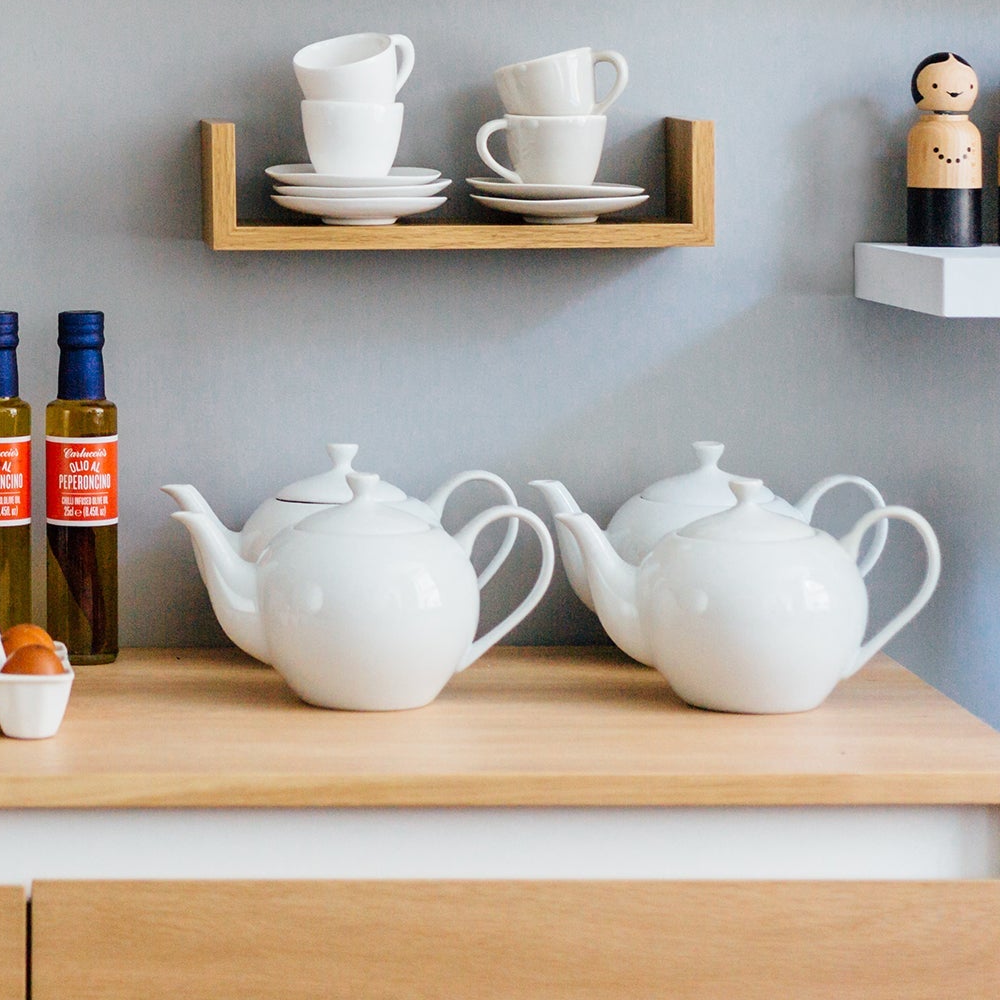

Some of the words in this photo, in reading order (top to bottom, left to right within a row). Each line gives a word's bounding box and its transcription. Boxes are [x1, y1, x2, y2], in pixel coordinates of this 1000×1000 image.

[63, 448, 107, 458] Carluccio's
[2, 461, 12, 473] AL
[69, 460, 89, 473] OLIO
[90, 461, 101, 473] AL
[58, 473, 111, 490] PEPERONCINO
